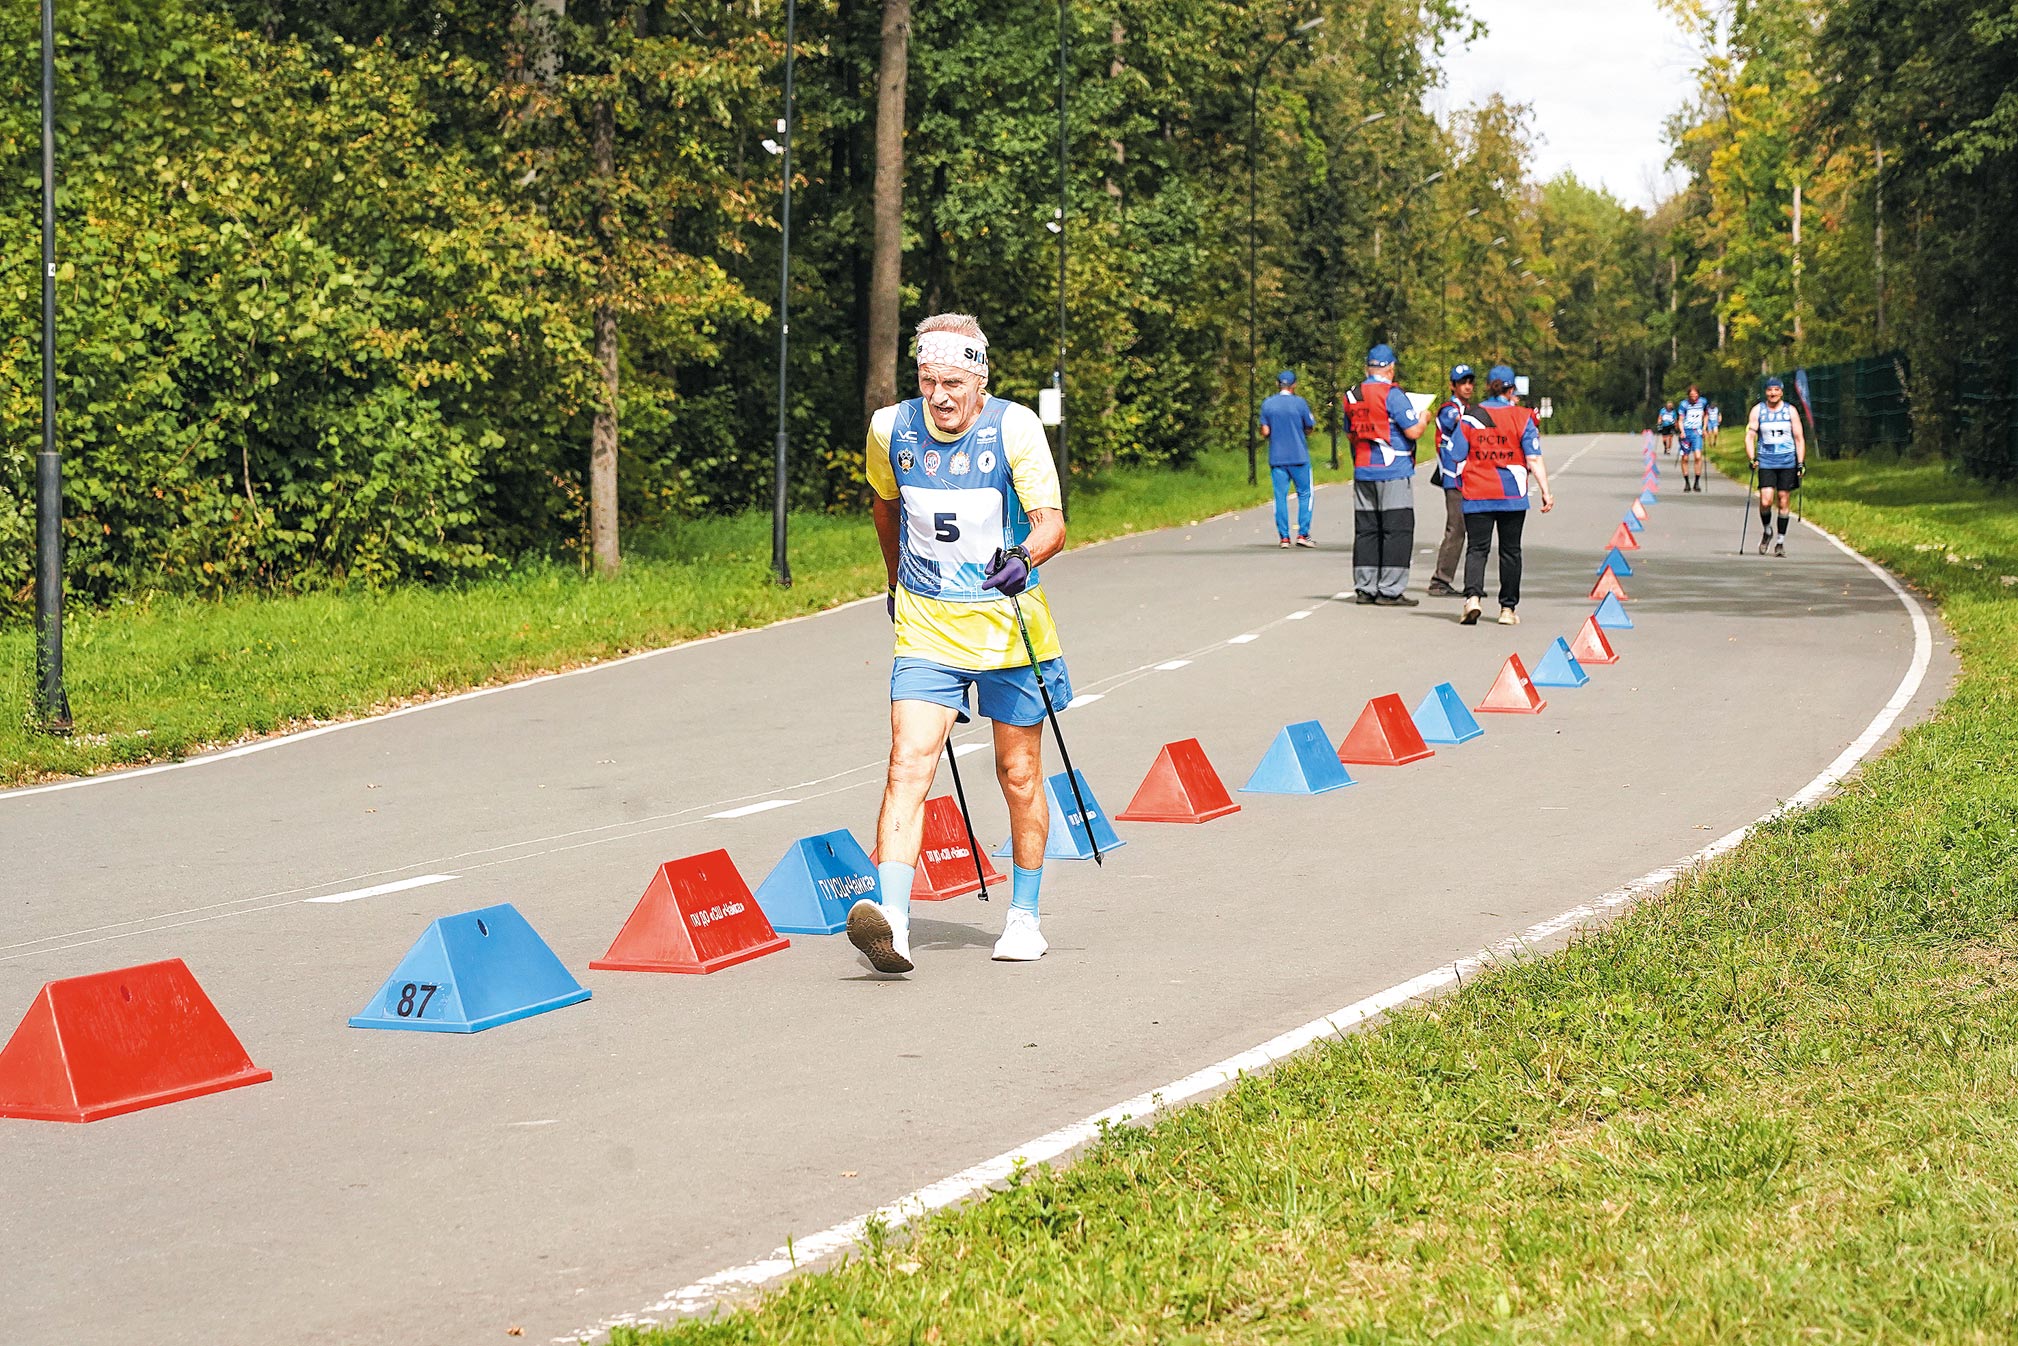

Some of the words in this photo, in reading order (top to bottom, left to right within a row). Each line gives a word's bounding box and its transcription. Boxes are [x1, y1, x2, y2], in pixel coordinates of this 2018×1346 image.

[1477, 435, 1507, 445] ФСТР
[934, 512, 960, 543] 5
[397, 983, 437, 1018] 87
